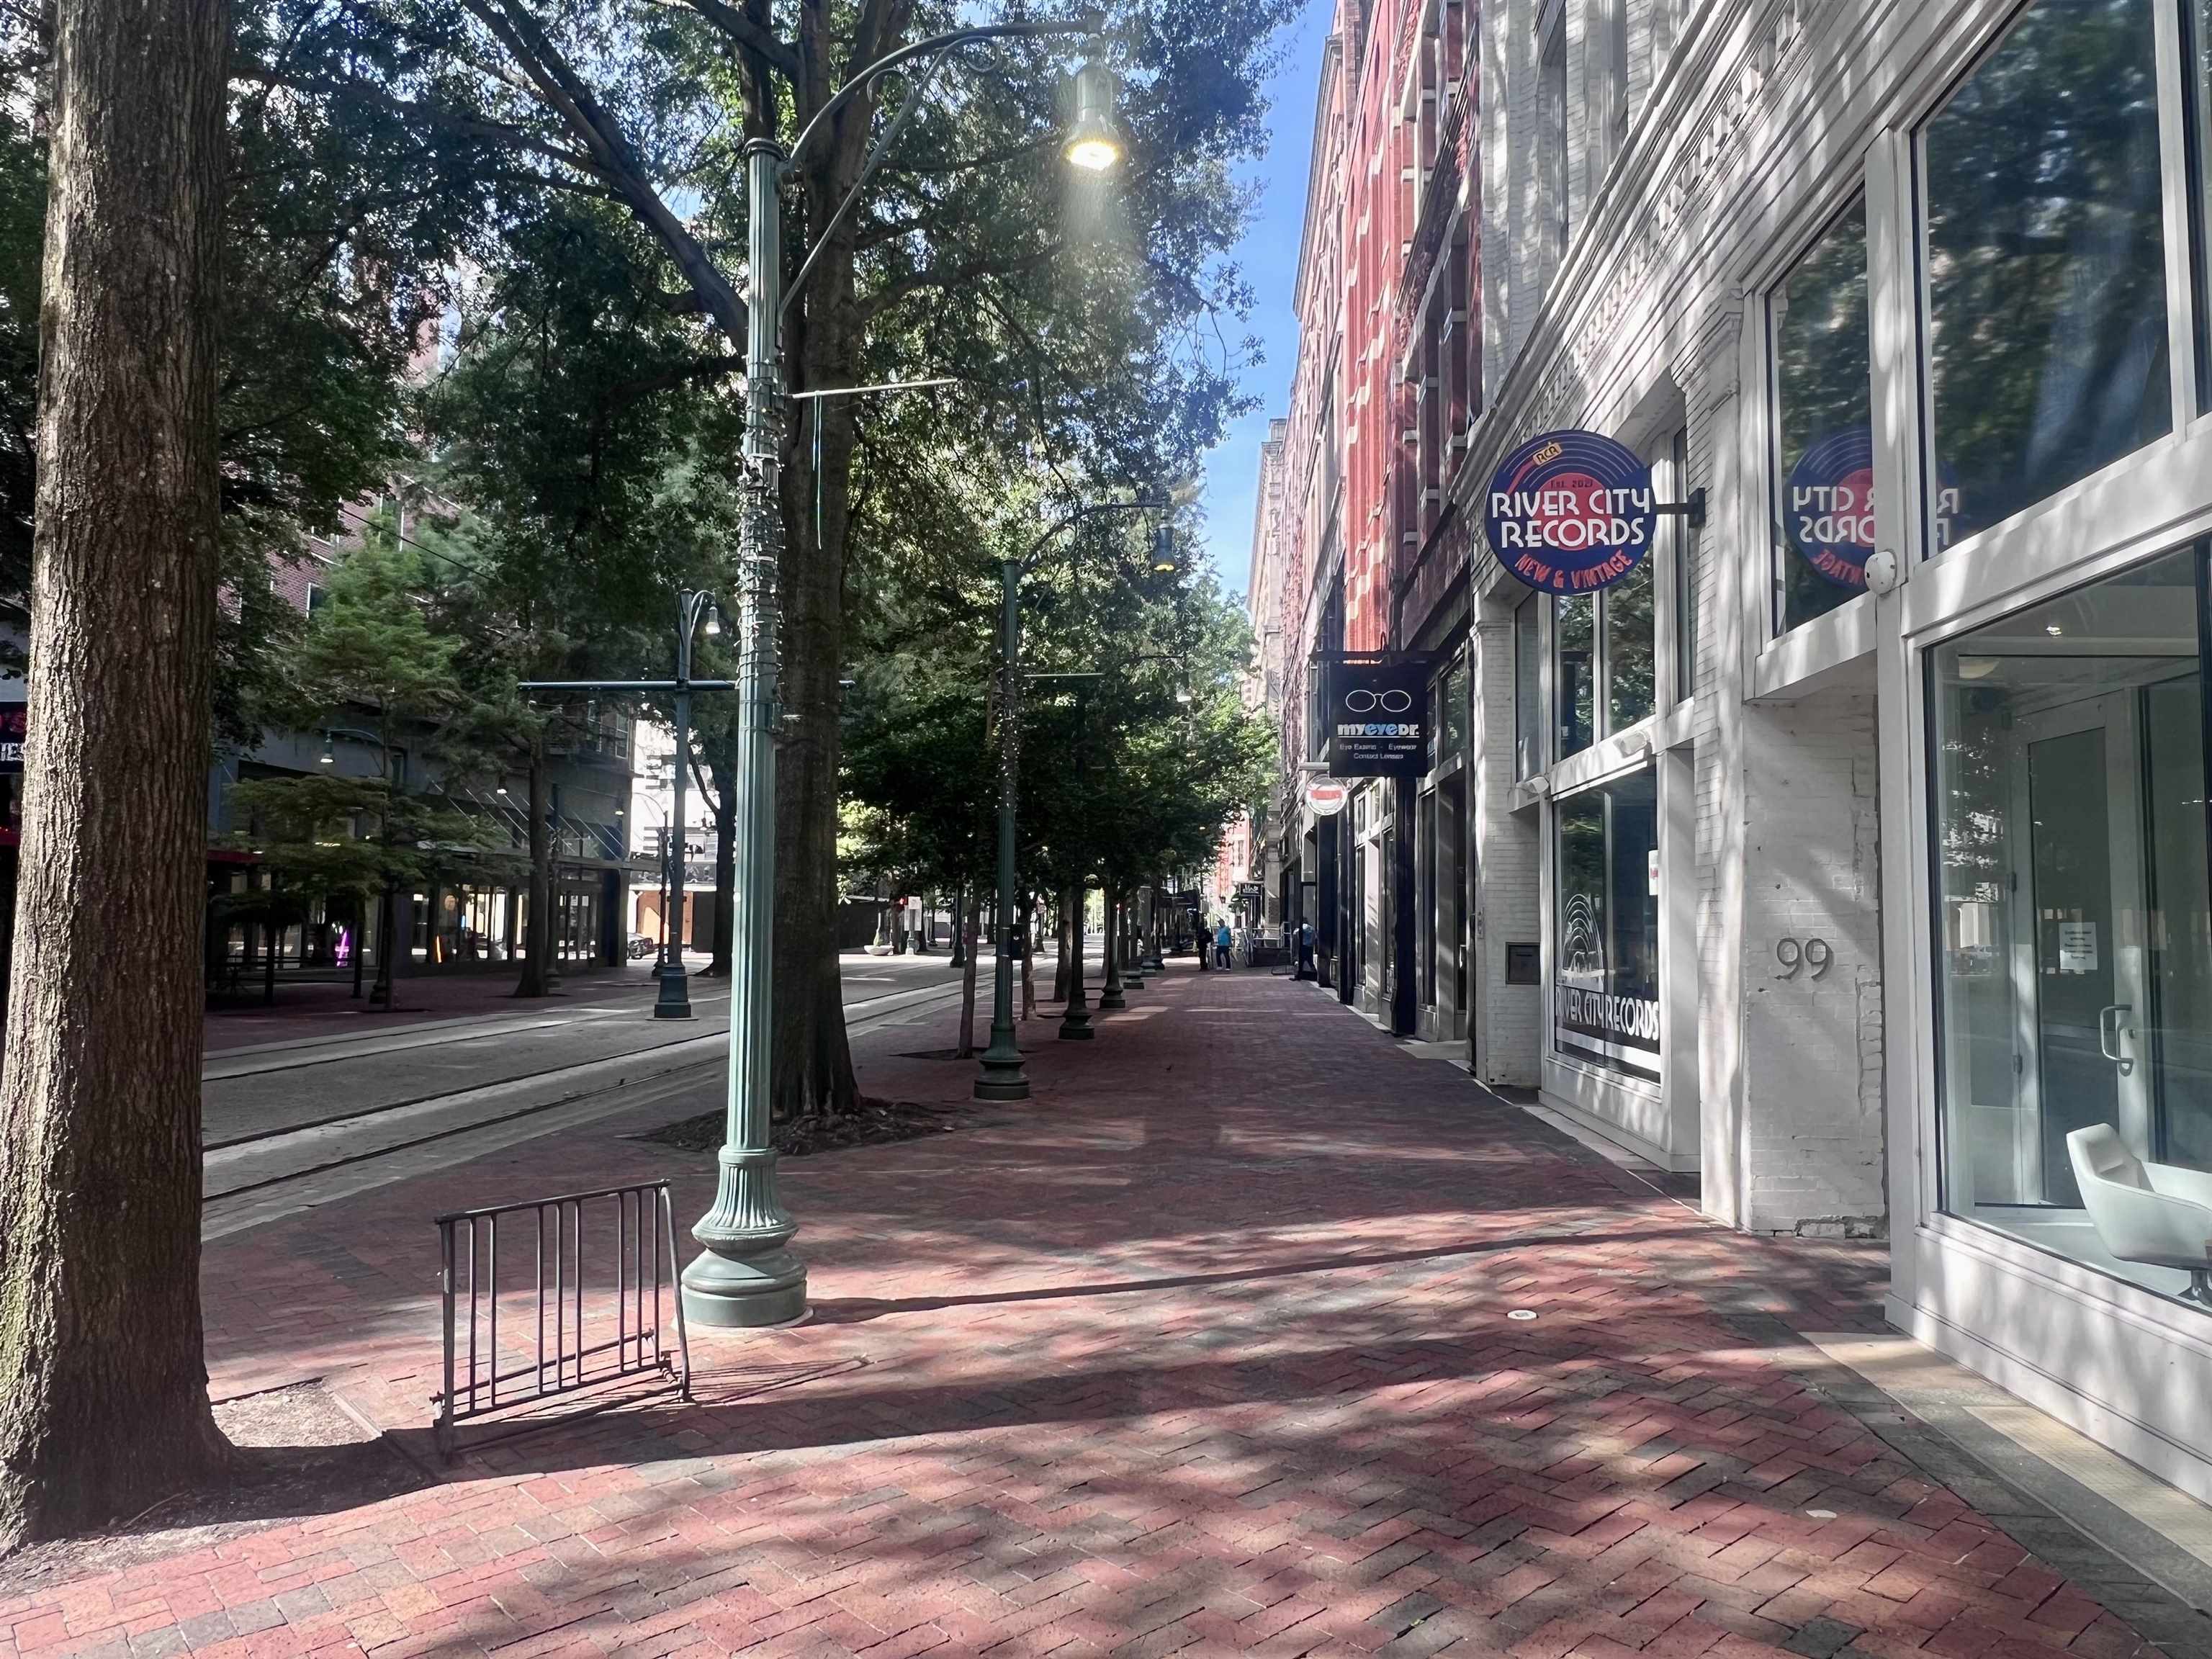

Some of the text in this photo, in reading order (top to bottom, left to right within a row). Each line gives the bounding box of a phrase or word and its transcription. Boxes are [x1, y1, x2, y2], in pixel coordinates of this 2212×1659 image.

[1536, 446, 1559, 463] RCR
[1492, 487, 1650, 518] RIVER CITY
[1501, 517, 1645, 548] RECORDS
[1514, 553, 1551, 583] NEW
[1570, 549, 1633, 589] VINTAGE
[1774, 938, 1833, 981] 99
[1584, 991, 1604, 1028] CITY
[1605, 994, 1659, 1040] RECORDS
